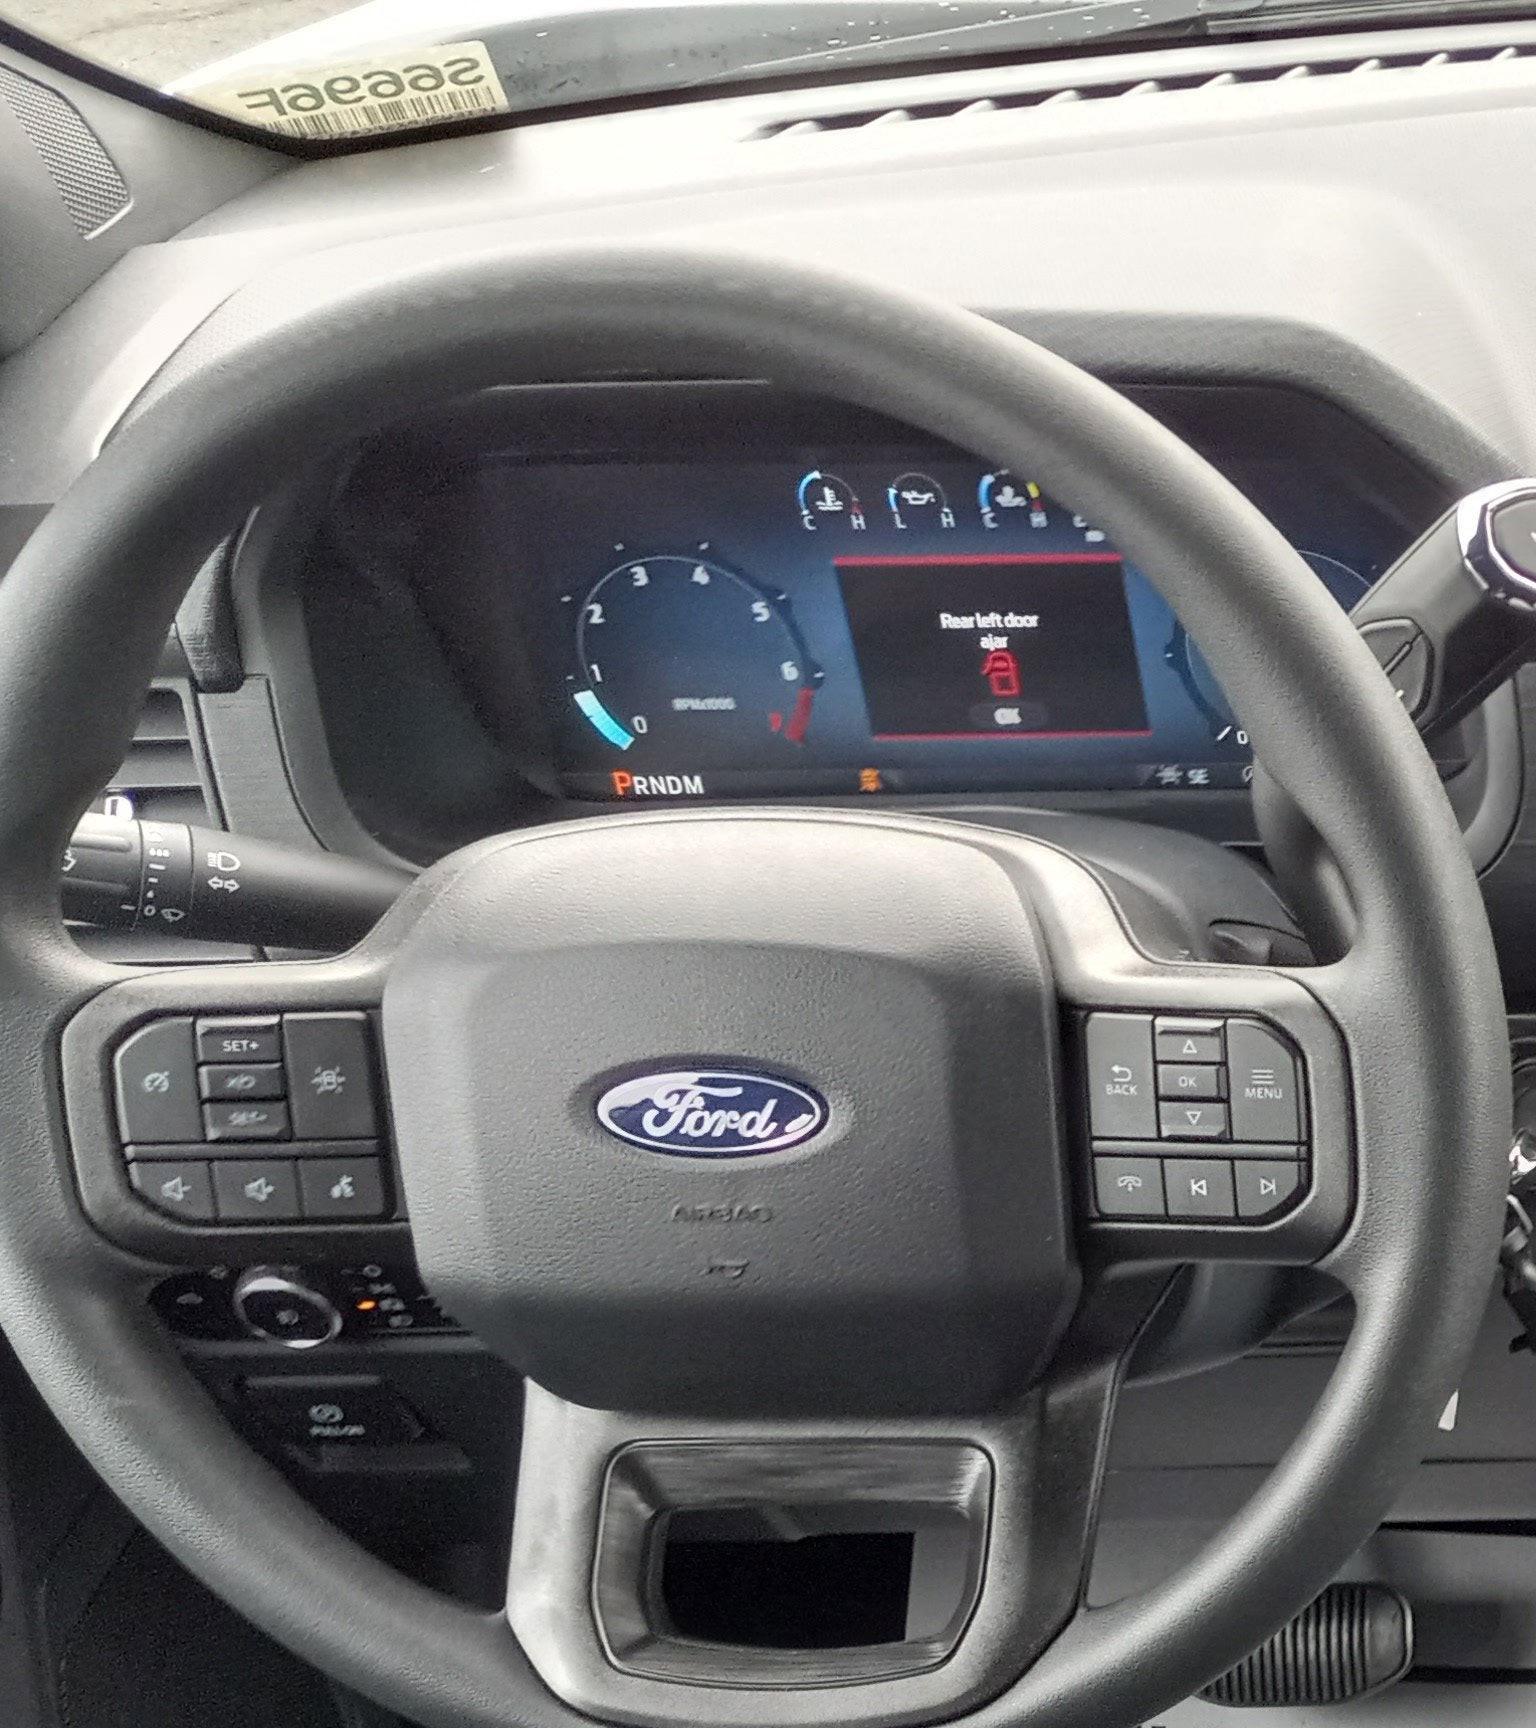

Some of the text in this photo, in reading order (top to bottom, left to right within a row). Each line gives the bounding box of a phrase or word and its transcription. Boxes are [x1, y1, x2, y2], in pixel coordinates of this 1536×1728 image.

[630, 566, 648, 586] 3
[692, 567, 710, 586] 4
[588, 603, 605, 625] 2
[751, 603, 770, 622] 5
[940, 612, 1039, 629] Rear left door
[980, 633, 1009, 651] ajar
[590, 665, 602, 683] 1
[781, 661, 799, 681] 6
[631, 716, 648, 734] 0
[222, 1039, 260, 1053] SET+
[1106, 1084, 1138, 1096] BACK
[1178, 1076, 1198, 1088] OK
[1245, 1087, 1283, 1099] MENU
[642, 1083, 778, 1138] Ford
